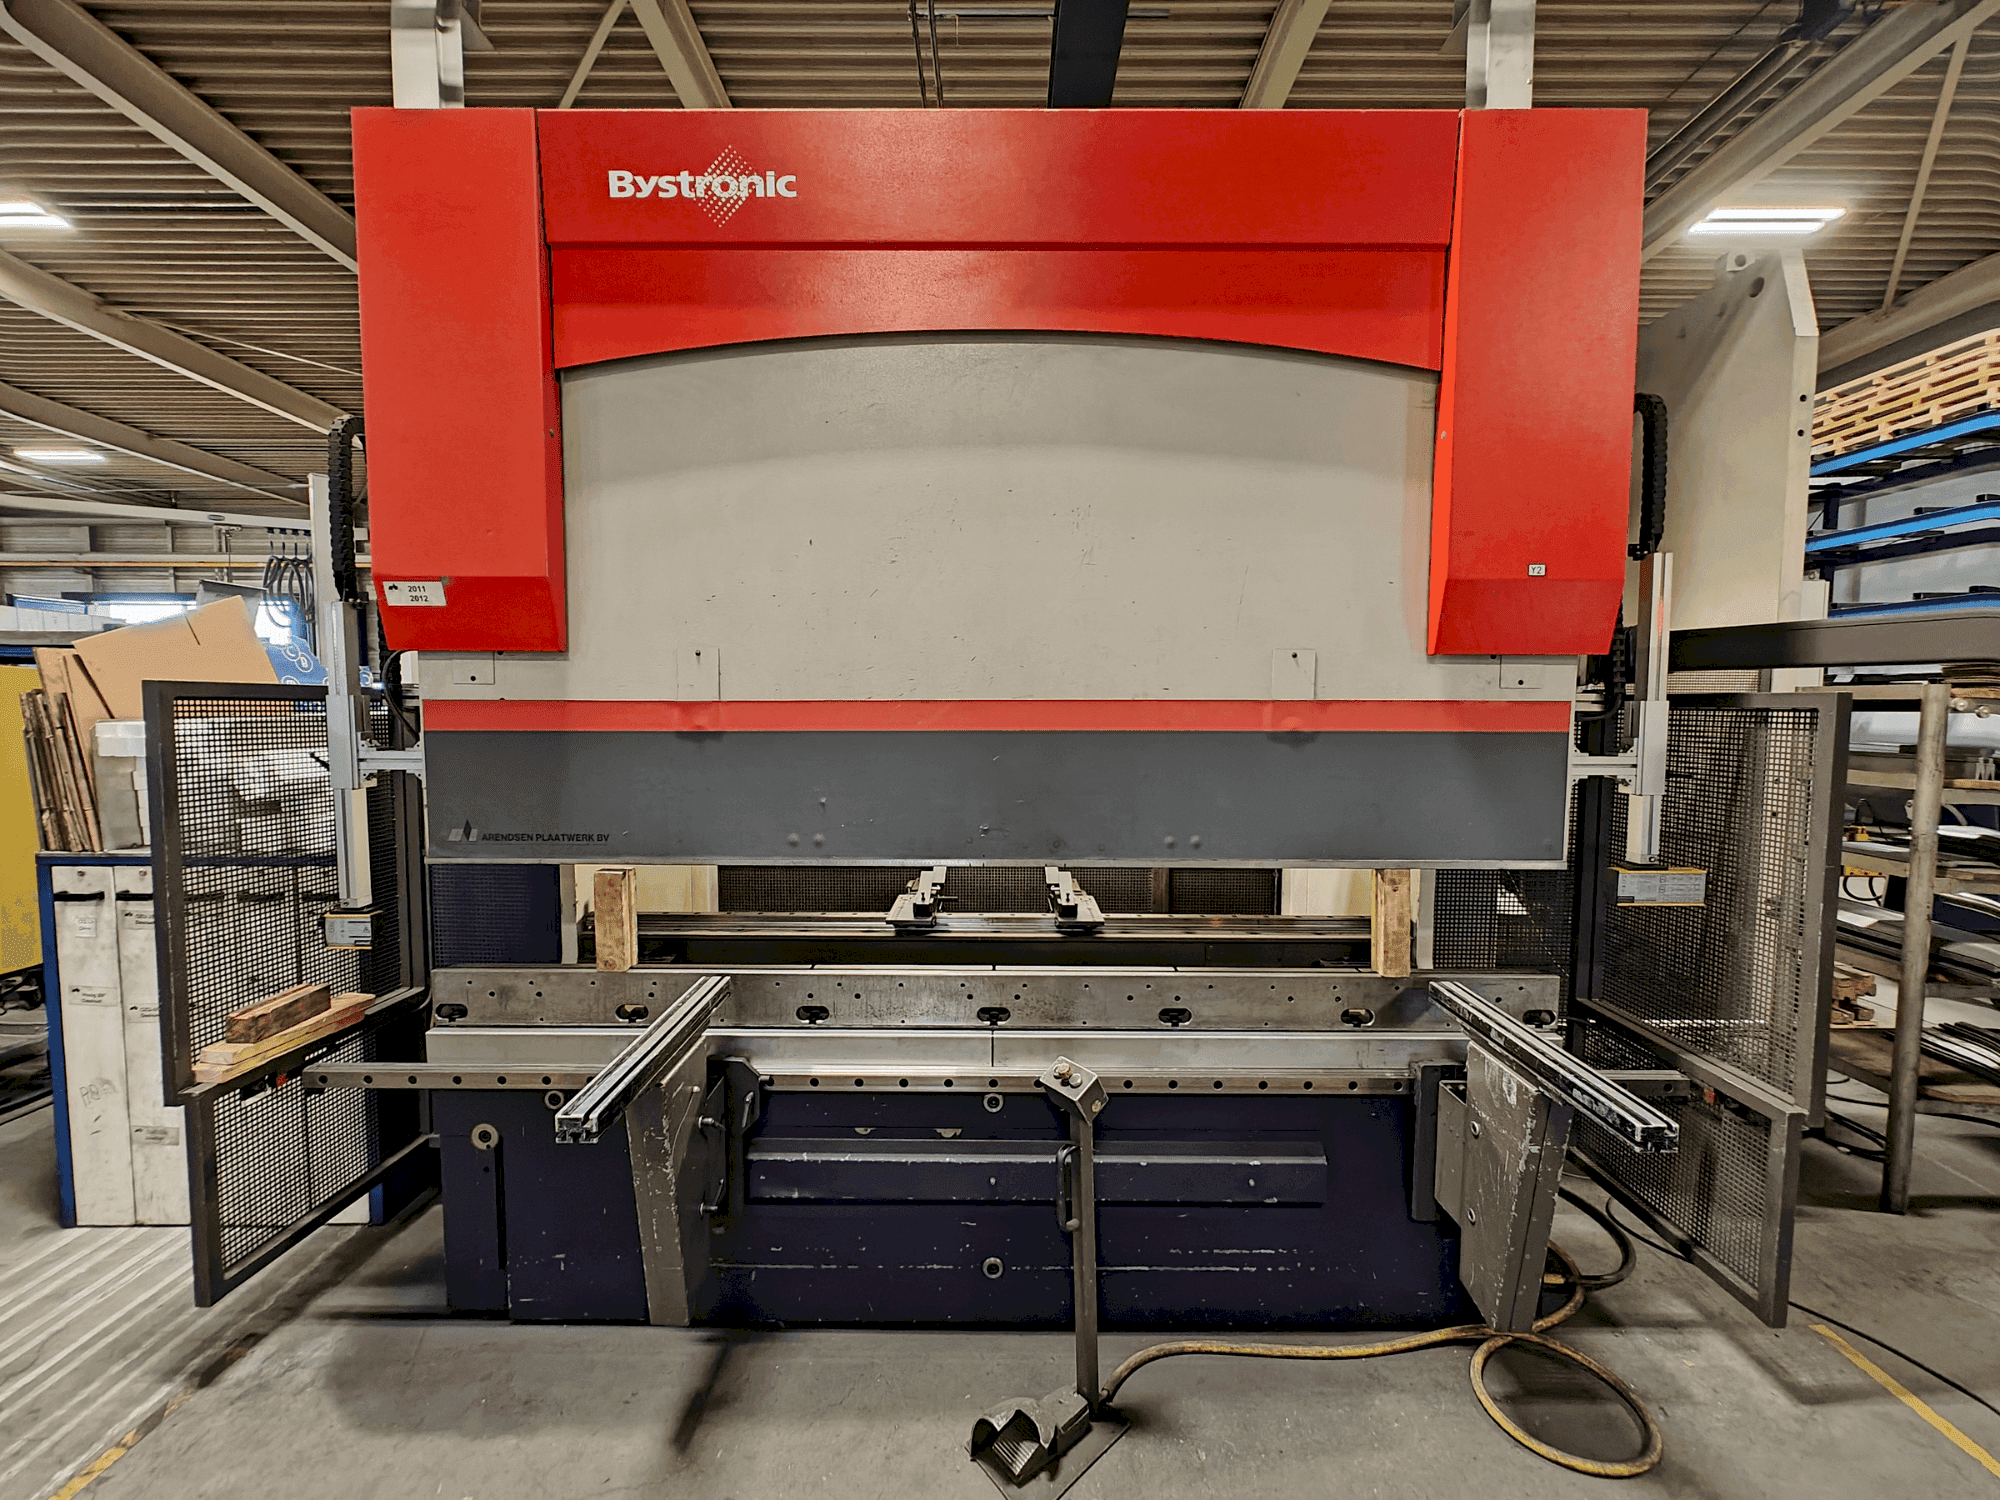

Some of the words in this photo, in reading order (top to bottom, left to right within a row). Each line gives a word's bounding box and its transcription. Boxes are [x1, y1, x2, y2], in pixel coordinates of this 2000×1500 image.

[608, 170, 798, 199] Bystronic
[1531, 566, 1542, 575] Y2
[407, 585, 426, 593] 2011
[409, 594, 429, 602] 2012
[481, 833, 534, 842] ARENDSEN
[535, 833, 595, 842] PLAATWERK
[596, 833, 610, 842] BV
